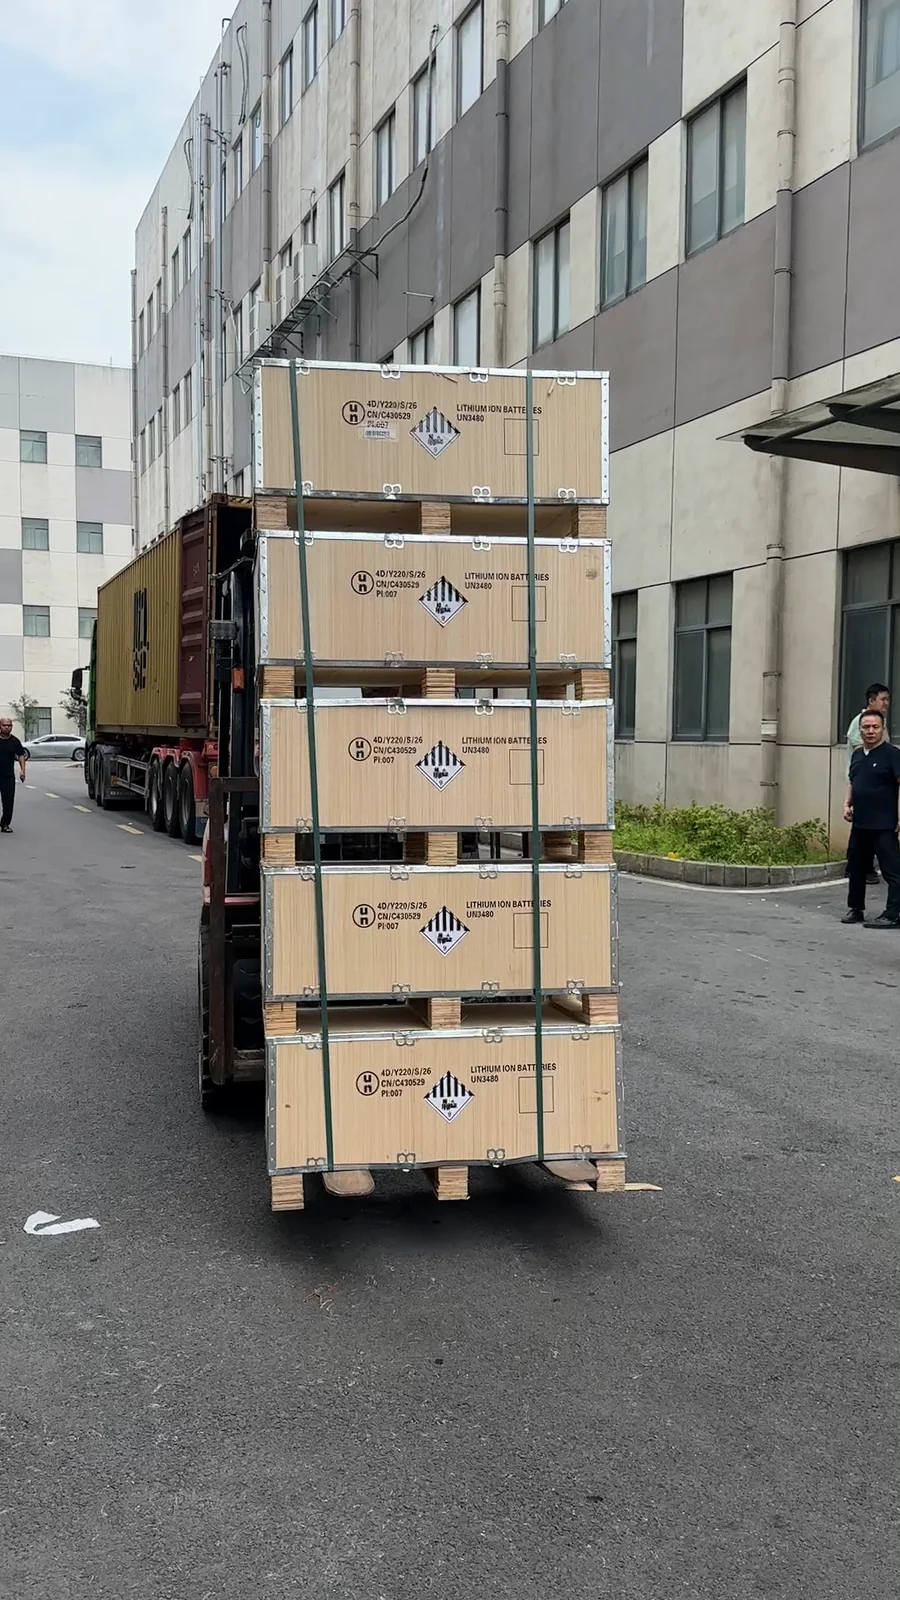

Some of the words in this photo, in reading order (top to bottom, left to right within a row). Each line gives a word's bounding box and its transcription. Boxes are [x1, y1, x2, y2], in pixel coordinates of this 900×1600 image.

[366, 400, 418, 409] 4D/Y220/S/26
[456, 404, 487, 412] LITHIUM
[488, 405, 502, 413] ION
[503, 406, 542, 414] BATTEES
[366, 410, 411, 420] CN/C430529
[456, 414, 484, 422] UN3480
[376, 570, 426, 579] 4D/Y220/S/26
[496, 572, 509, 580] ION
[376, 580, 420, 588] CN/C430529
[373, 736, 423, 744] 4D/Y220/S/26
[462, 736, 492, 744] LITHIUM
[494, 736, 506, 744] ION
[508, 736, 548, 744] BATTEES
[373, 746, 417, 754] CN/C430529
[377, 902, 428, 910] 4D/Y220/S/26
[466, 900, 496, 908] LITHIUM
[381, 1067, 432, 1076] 4D/Y220/S/26
[470, 1065, 501, 1074] LITHIUM
[517, 1063, 556, 1072] BATTRIES
[381, 1078, 426, 1088] CN/C430529
[470, 1075, 499, 1083] UN3480
